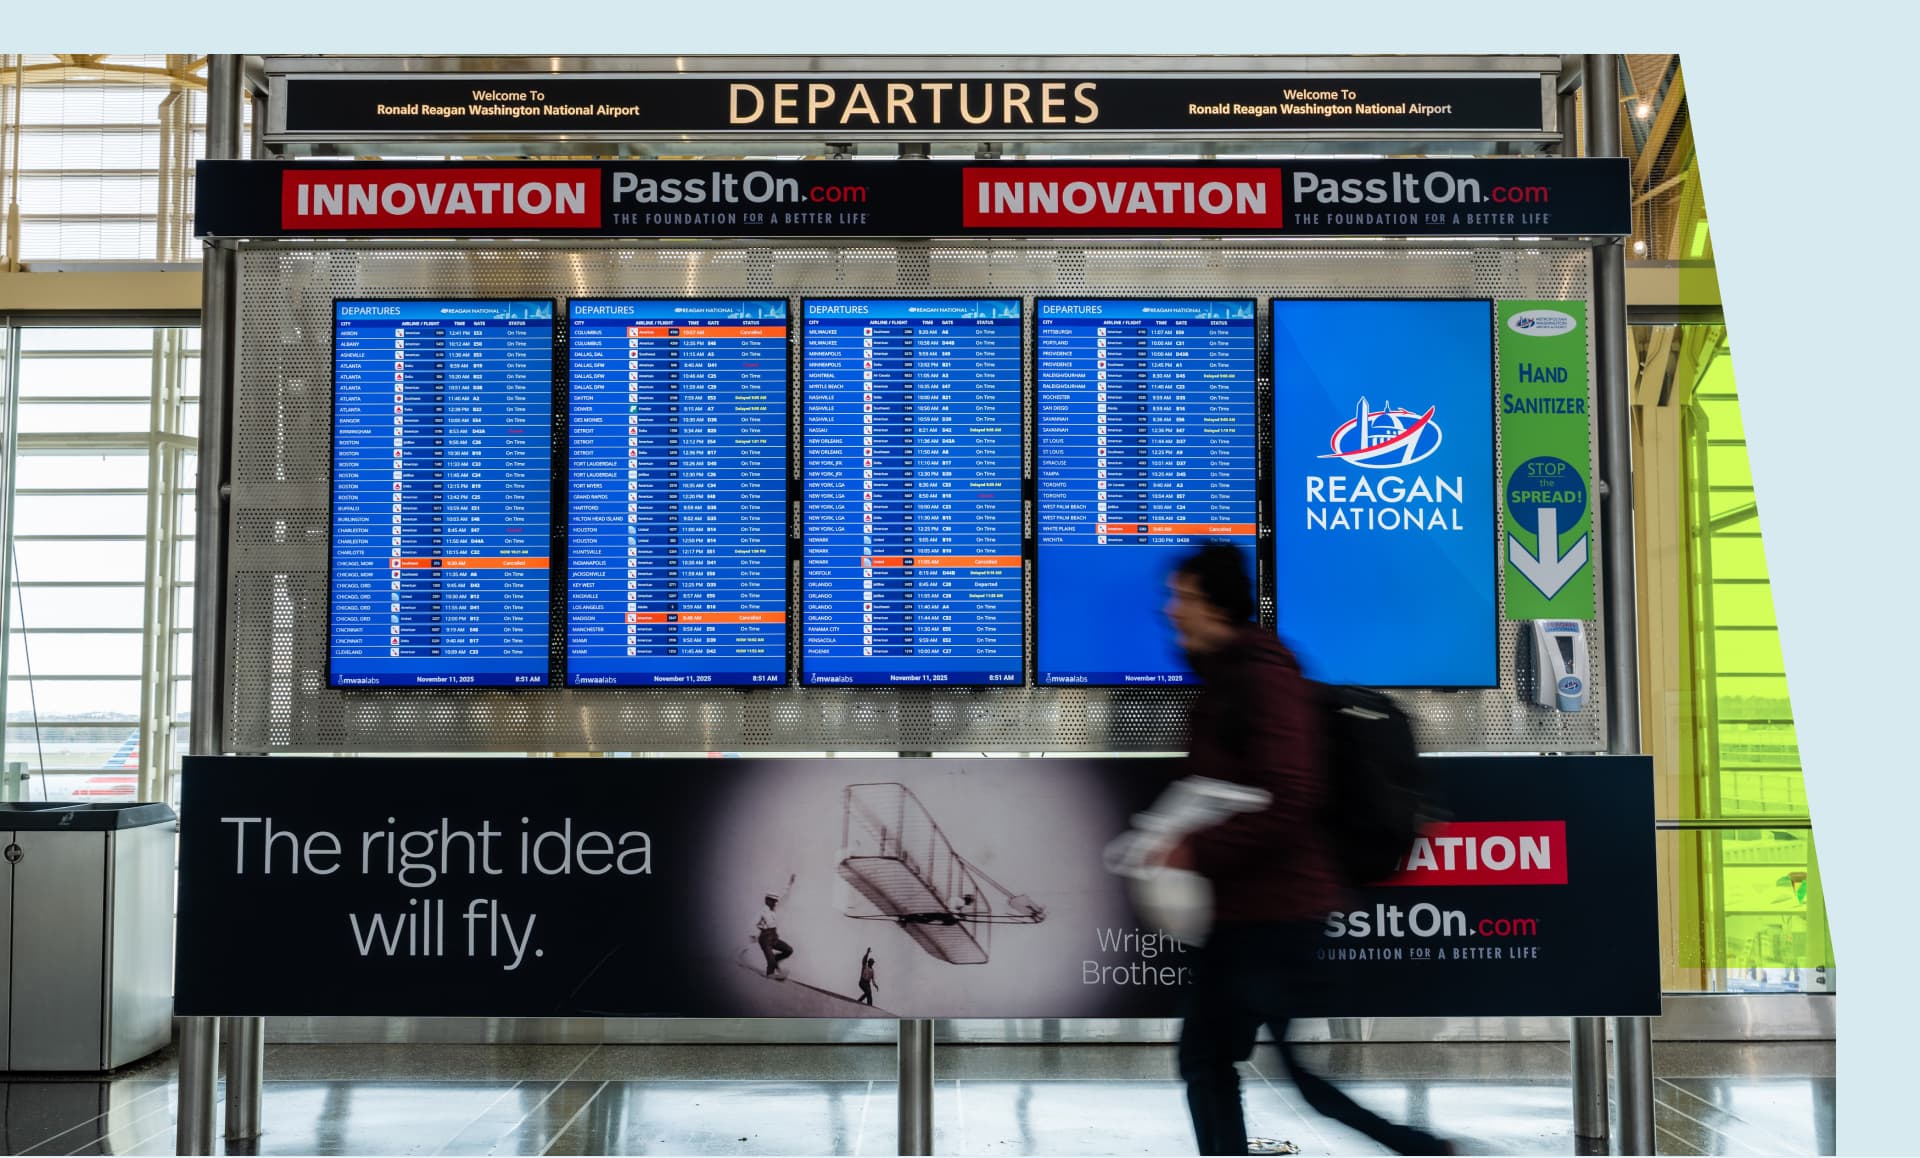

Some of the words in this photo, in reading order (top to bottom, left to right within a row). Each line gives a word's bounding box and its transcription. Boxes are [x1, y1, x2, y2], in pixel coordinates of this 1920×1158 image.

[472, 90, 527, 101] Welcome
[529, 90, 545, 101] To
[1283, 89, 1338, 100] Welcome
[1340, 89, 1356, 100] To
[730, 82, 1099, 124] DEPARTURES
[377, 104, 419, 115] Ronald
[422, 104, 466, 118] Reagan
[468, 104, 540, 118] Washington
[544, 104, 594, 115] National
[596, 104, 640, 118] Airport
[1189, 103, 1230, 114] Ronald
[1233, 104, 1277, 117] Reagan
[1280, 103, 1352, 117] Washington
[1355, 103, 1406, 114] National
[1408, 103, 1452, 116] Airport
[298, 182, 585, 215] INNOVATION
[979, 181, 1266, 215] INNOVATION
[613, 213, 637, 224] THE
[646, 213, 736, 224] FOUNDATION
[743, 213, 763, 224] FOR
[771, 213, 778, 224] A
[785, 213, 832, 224] BETTER
[840, 213, 866, 224] LIFE
[1295, 213, 1319, 224] THE
[1327, 213, 1417, 224] FOUNDATION
[1425, 213, 1445, 224] FOR
[1453, 213, 1460, 224] A
[1467, 213, 1514, 224] BETTER
[1522, 213, 1549, 224] LIFE
[341, 307, 401, 315] DEPARTURES
[575, 306, 634, 314] DEPARTURES
[809, 305, 869, 314] DEPARTURES
[1043, 305, 1102, 314] DEPARTURES
[1527, 462, 1565, 476] STOP
[1306, 475, 1463, 503] REAGAN
[1539, 479, 1554, 487] the
[1511, 490, 1582, 504] SPREAD!
[1307, 507, 1463, 531] NATIONAL
[344, 676, 379, 684] mwaalabs
[449, 675, 458, 683] 11,
[581, 675, 617, 684] mwaalabs
[923, 674, 931, 682] 11,
[220, 817, 341, 875] The
[362, 817, 503, 888] right
[521, 817, 652, 875] idea
[1402, 836, 1551, 871] ATION
[349, 898, 443, 956] will
[462, 898, 543, 970] fly.
[1317, 948, 1402, 960] OUNDATION
[1410, 948, 1431, 959] FOR
[1439, 948, 1446, 959] A
[1454, 948, 1502, 959] BETTER
[1510, 947, 1537, 959] LIFE
